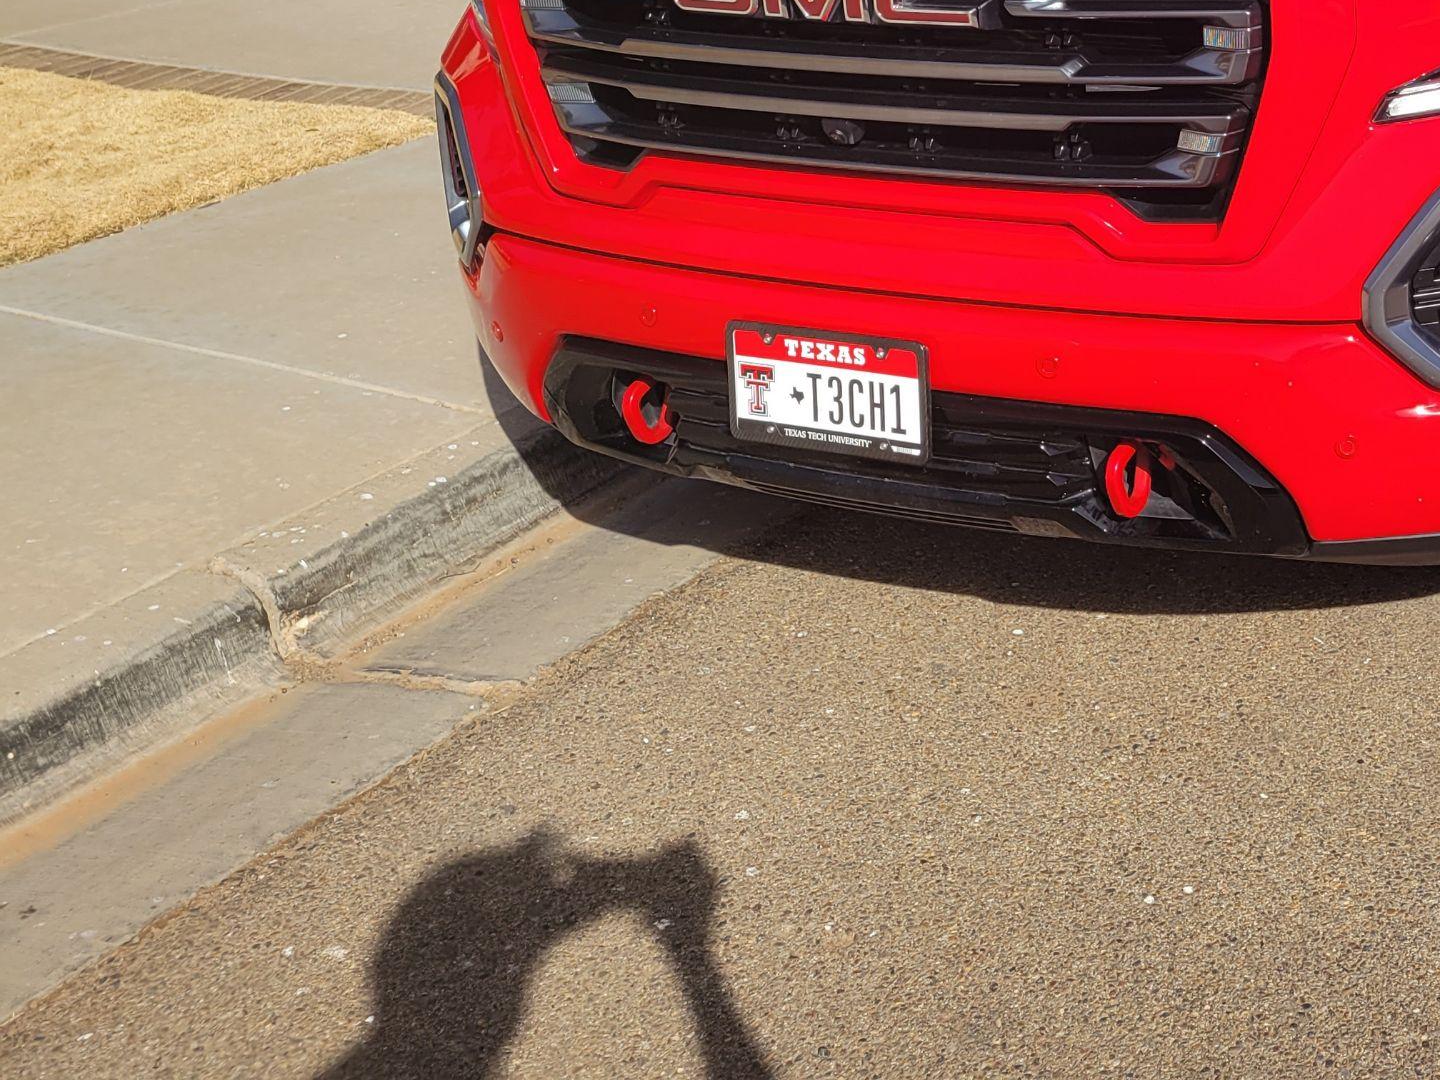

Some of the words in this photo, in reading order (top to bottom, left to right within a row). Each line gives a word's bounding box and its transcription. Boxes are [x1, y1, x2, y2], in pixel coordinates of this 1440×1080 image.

[783, 338, 867, 366] TEXAS
[806, 372, 907, 436] T3CH1
[784, 427, 806, 439] TEXAS
[807, 431, 827, 441] TECH
[828, 434, 871, 448] UNIVERSITY
